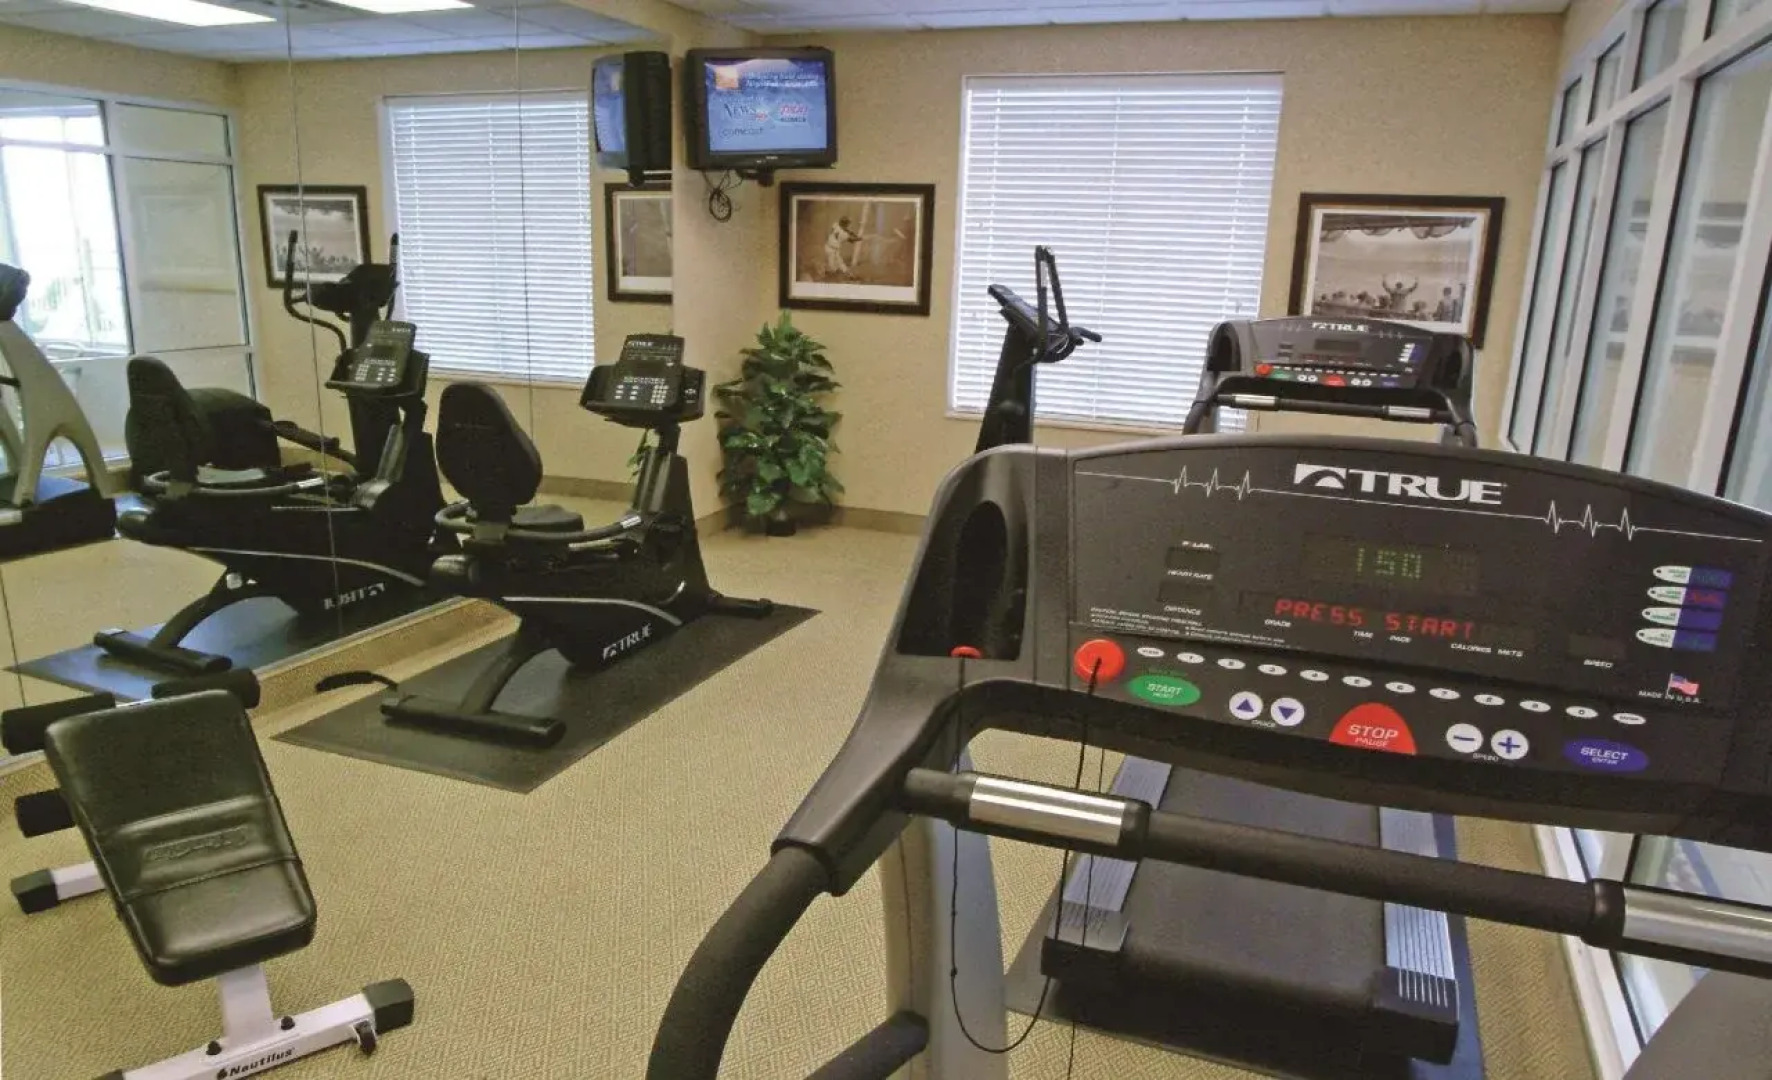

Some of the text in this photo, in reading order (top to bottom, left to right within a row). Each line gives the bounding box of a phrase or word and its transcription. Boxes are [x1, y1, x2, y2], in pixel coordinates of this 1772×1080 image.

[1348, 469, 1502, 505] TRUE
[1355, 547, 1422, 579] 150
[1274, 597, 1474, 641] PRESS START
[617, 622, 652, 652] TRUE
[1353, 630, 1374, 639] TIME
[1497, 648, 1524, 658] METS
[1147, 683, 1182, 695] START
[1347, 723, 1399, 740] STOP
[1354, 736, 1389, 748] PAUSE
[1580, 747, 1629, 761] SELECT
[229, 1048, 293, 1076] Nautilus
